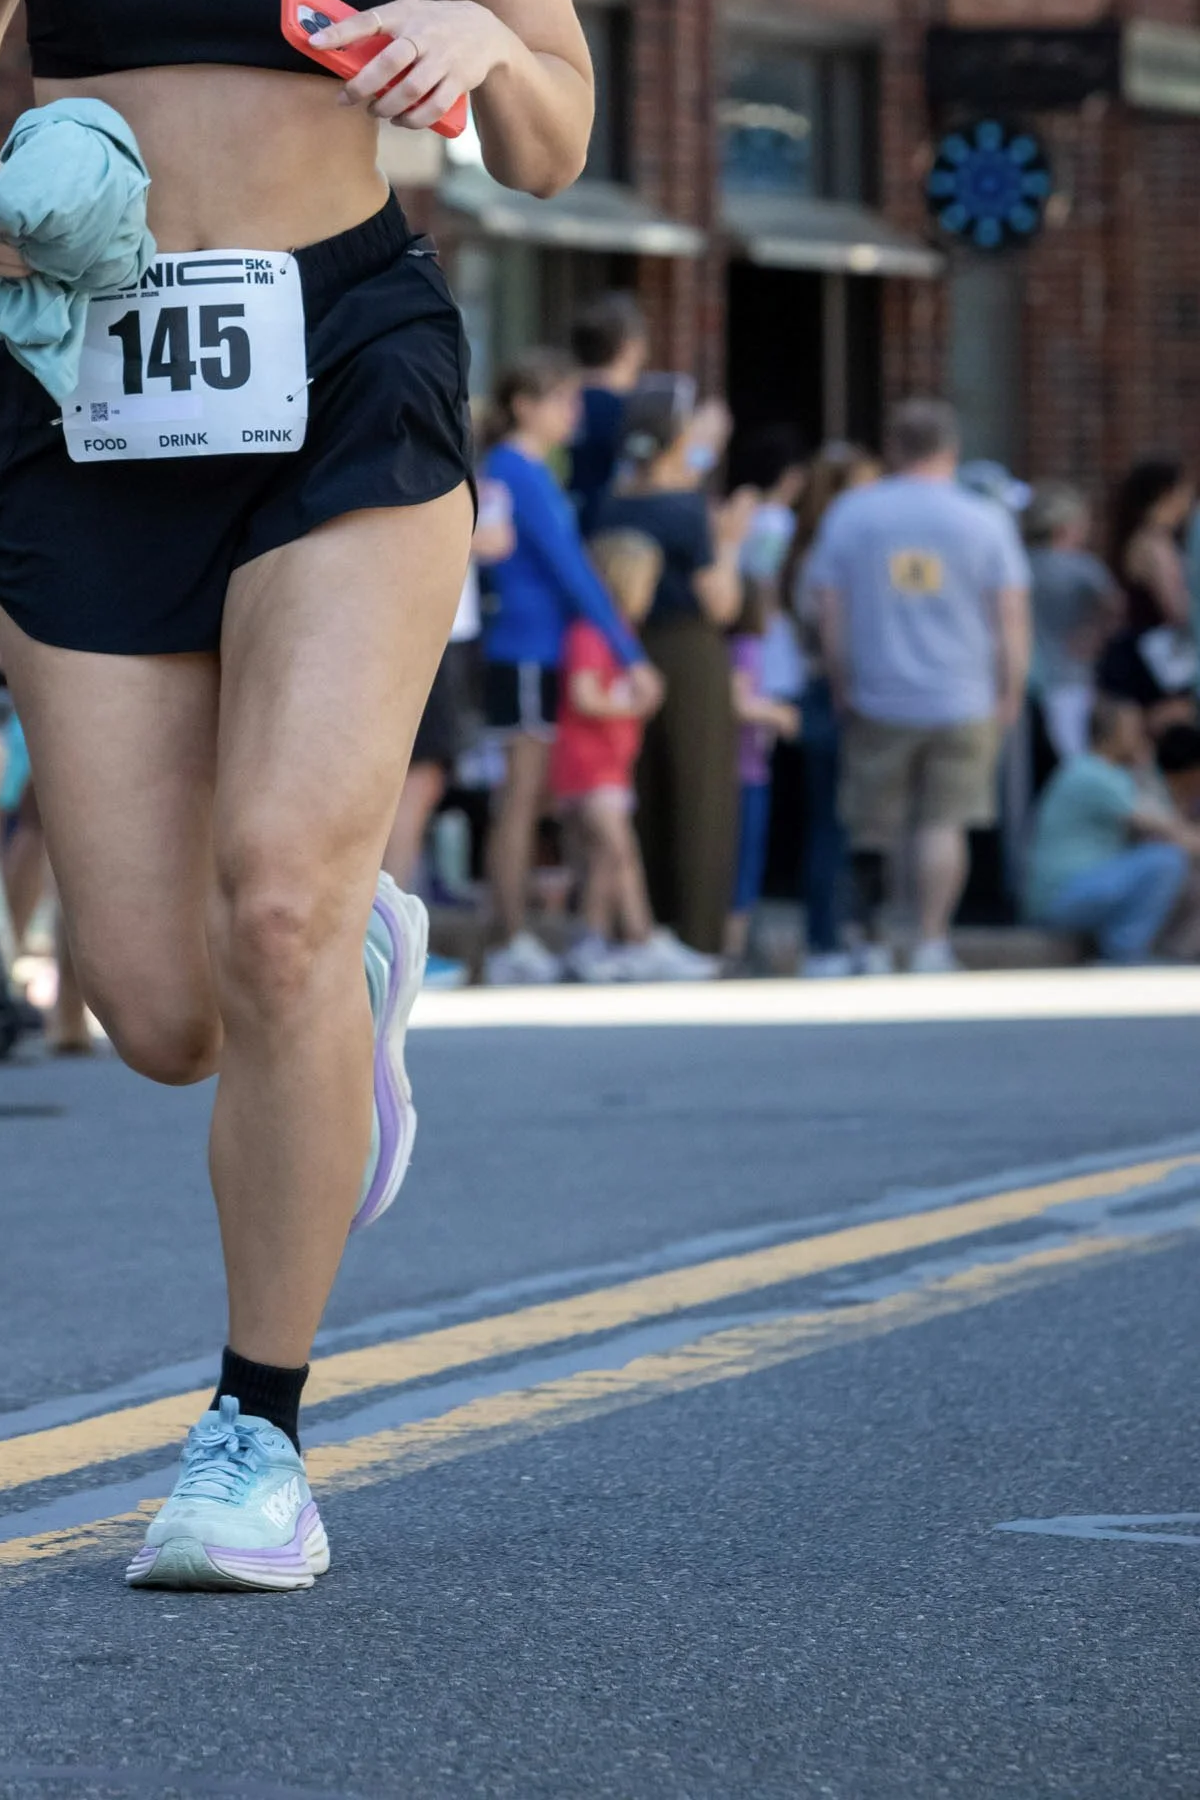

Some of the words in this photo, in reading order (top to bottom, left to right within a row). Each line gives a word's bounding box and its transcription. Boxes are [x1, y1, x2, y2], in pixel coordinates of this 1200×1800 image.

[118, 258, 244, 291] NIC
[108, 303, 251, 395] 145
[84, 438, 128, 452] FOOD
[159, 432, 209, 448] DRINK
[242, 429, 293, 443] DRINK
